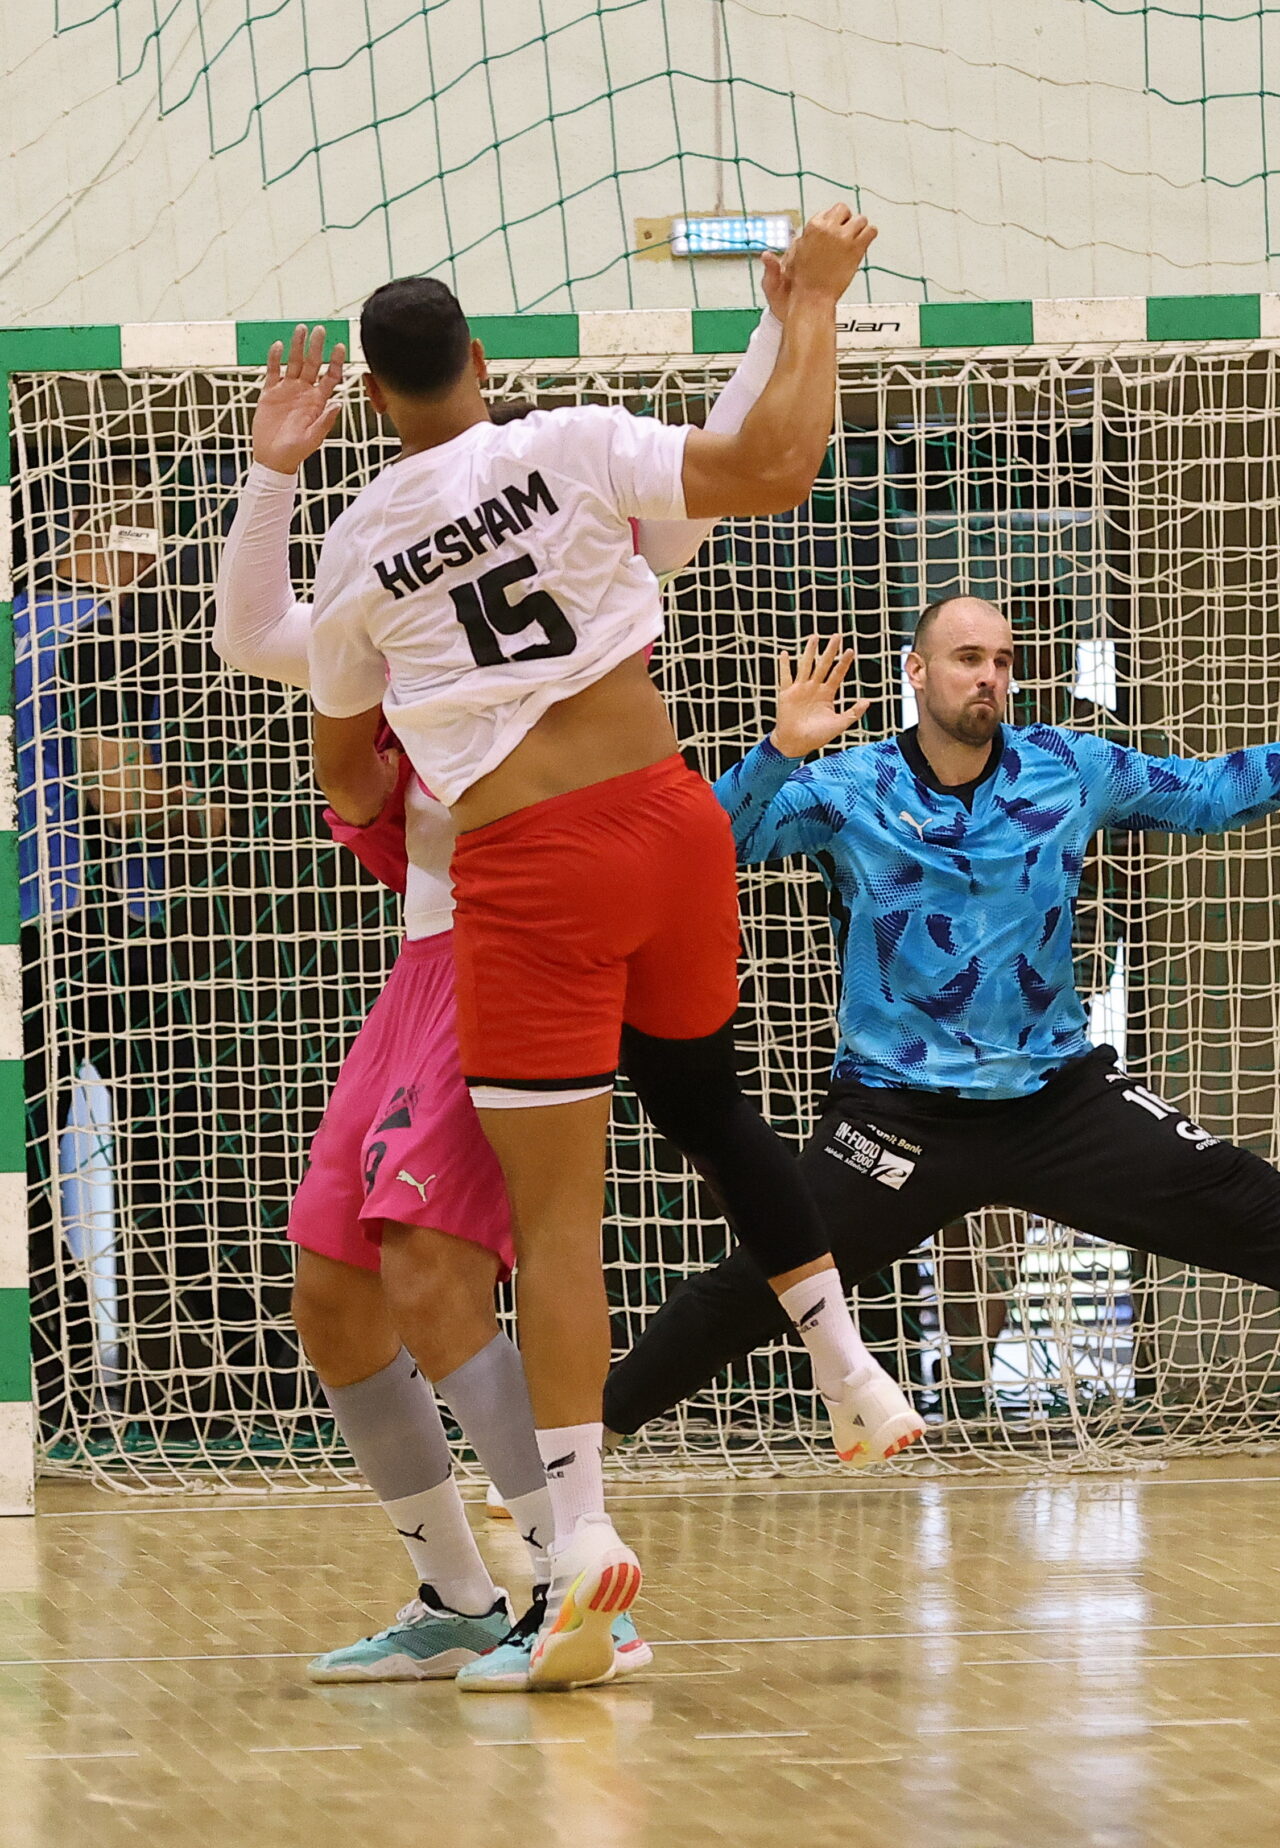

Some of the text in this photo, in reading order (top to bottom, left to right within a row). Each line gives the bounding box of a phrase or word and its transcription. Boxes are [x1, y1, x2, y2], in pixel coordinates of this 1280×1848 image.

[373, 470, 560, 600] HESHAM
[448, 553, 578, 668] 15
[834, 1121, 881, 1160] IN-FOOD
[850, 1150, 875, 1169] 2000
